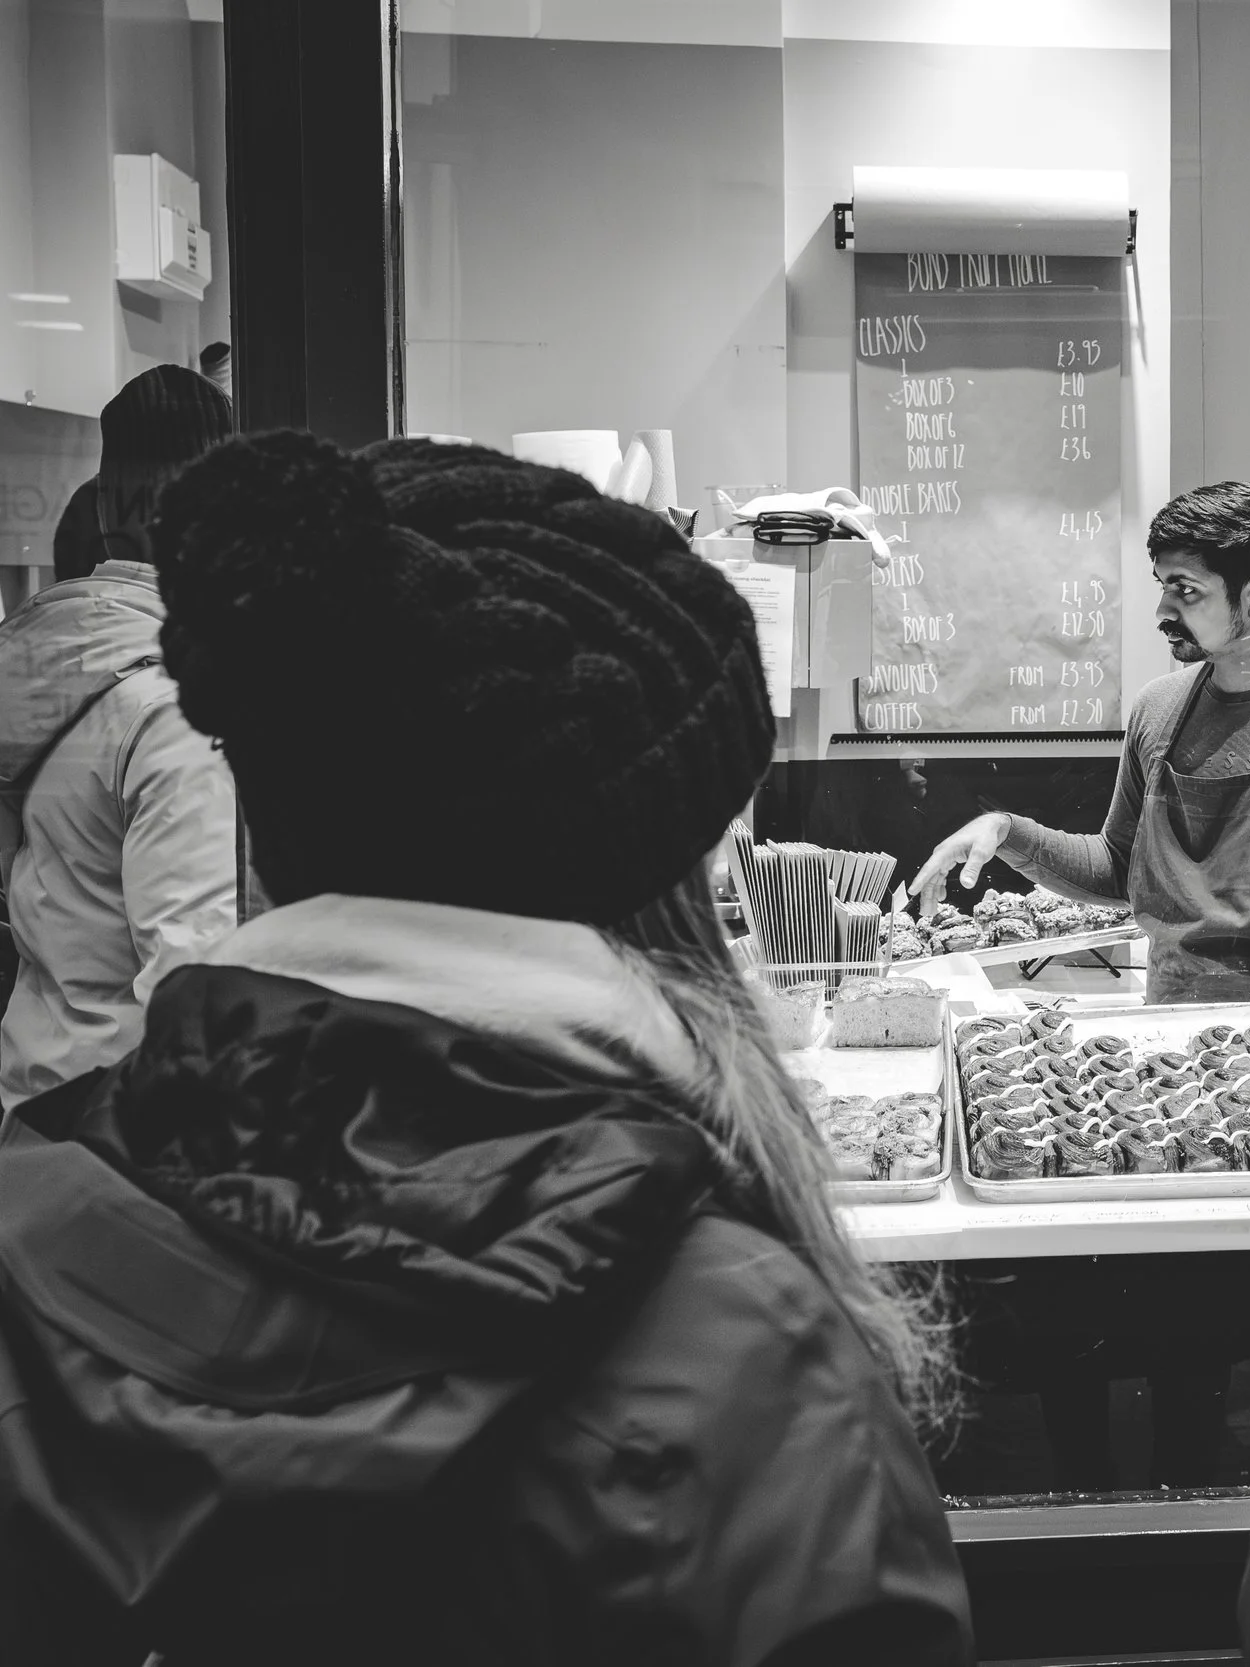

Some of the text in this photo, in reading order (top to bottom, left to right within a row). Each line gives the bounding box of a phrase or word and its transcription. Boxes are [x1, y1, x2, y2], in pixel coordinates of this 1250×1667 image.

[859, 315, 926, 356] CLASSICS
[901, 340, 1101, 377] 1 £3.95
[903, 372, 1084, 408] BOX OF 3 £10
[906, 404, 1086, 442] BOX OF 6 £19
[907, 436, 1091, 471] BOX OF 12 £36
[862, 481, 961, 516] DOUBLE BAKES
[1059, 511, 1103, 541] £4.45
[902, 580, 1106, 611] 1 £4.95
[903, 615, 927, 644] BOX
[929, 616, 943, 641] OF
[946, 612, 956, 641] 3
[867, 660, 1104, 696] SAVOURIES FROM £3.95
[864, 698, 1103, 731] COFFEES FROM £2.50
